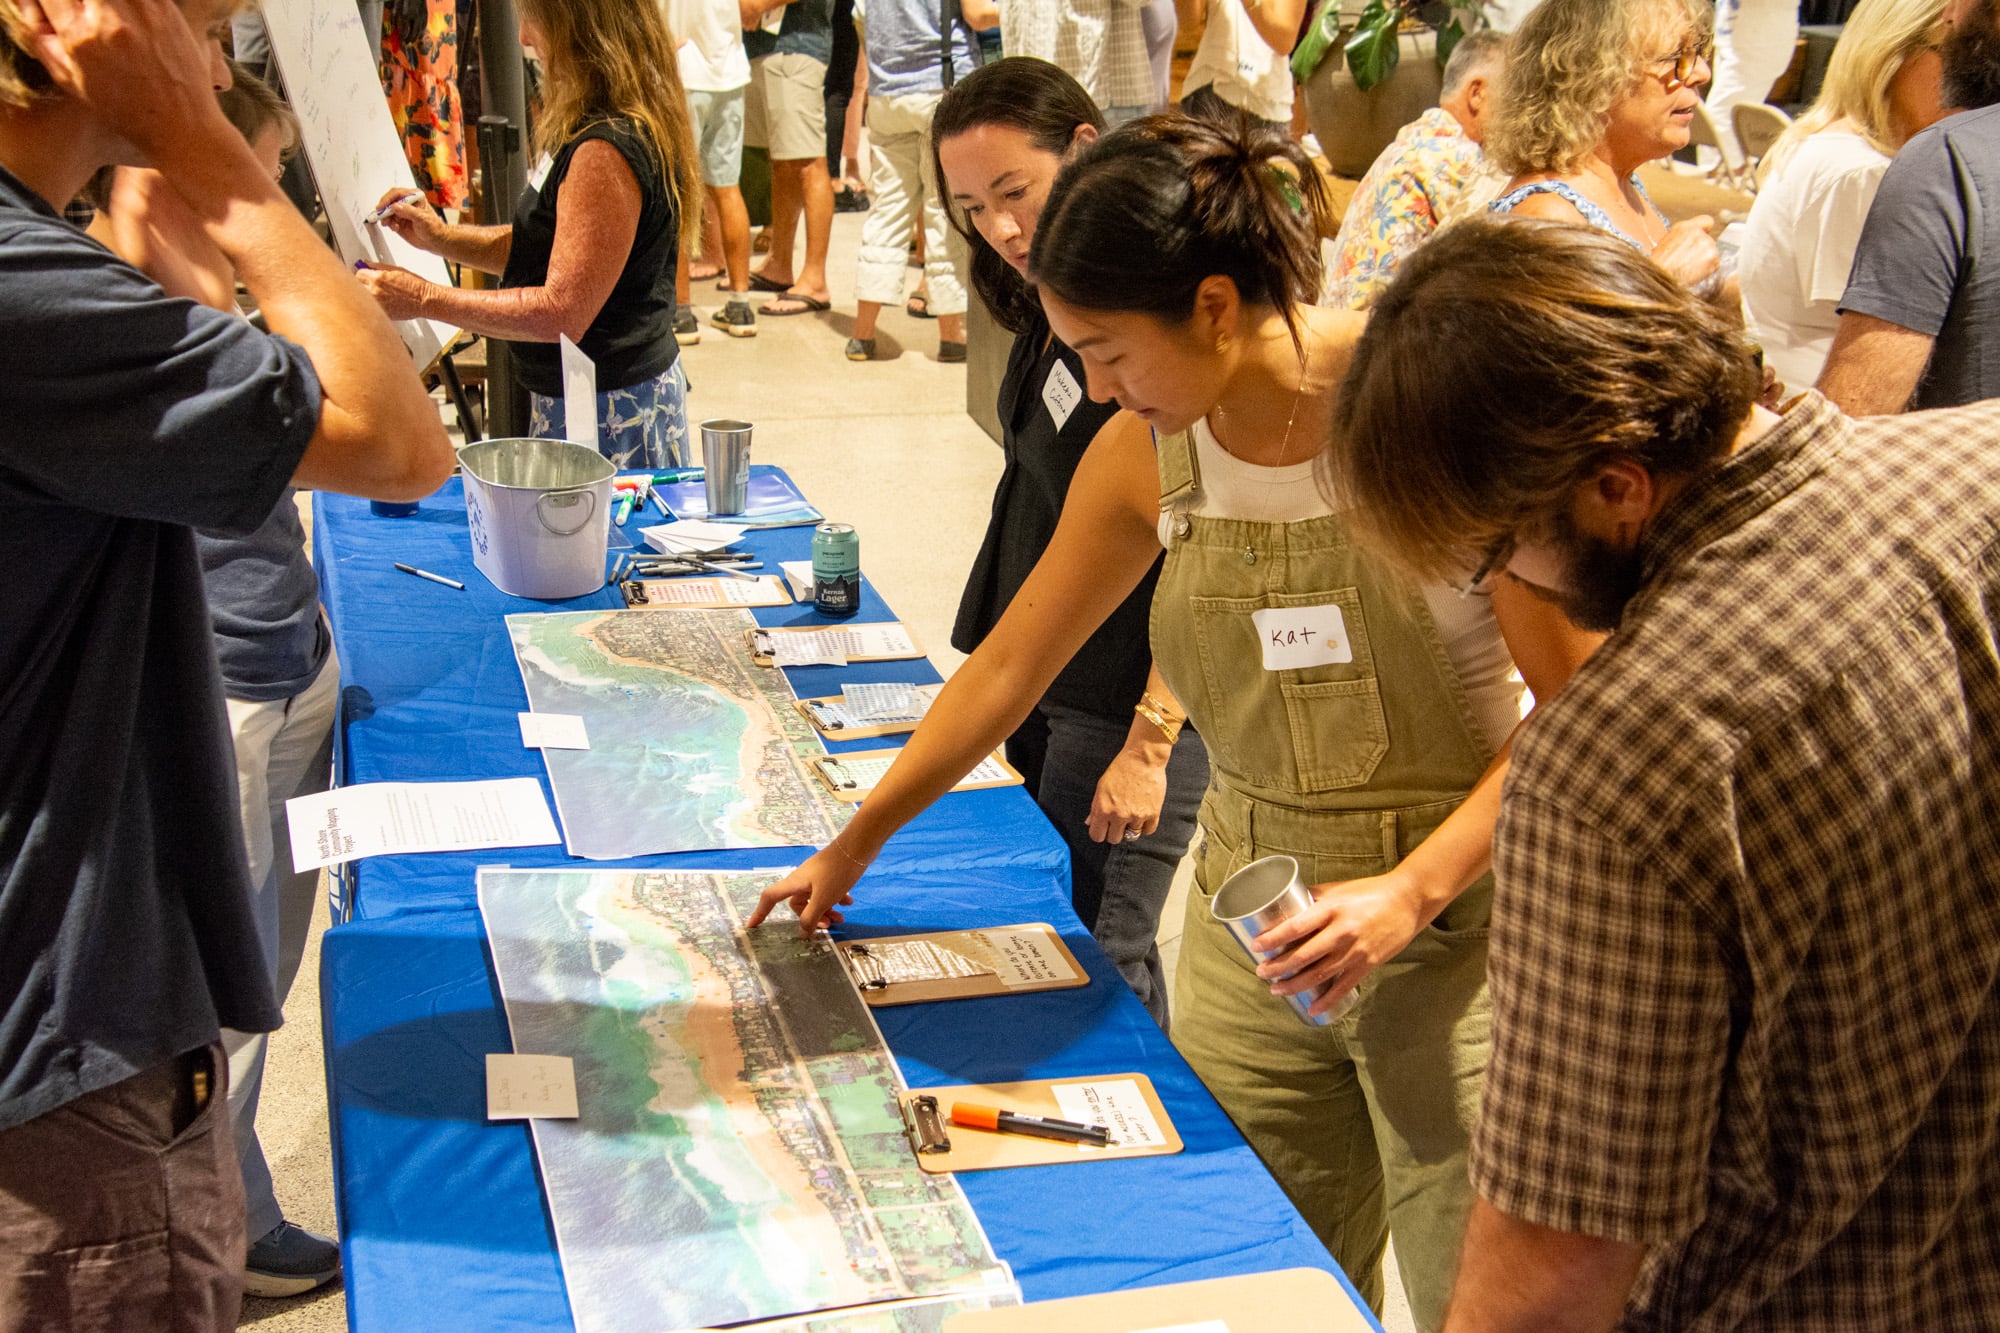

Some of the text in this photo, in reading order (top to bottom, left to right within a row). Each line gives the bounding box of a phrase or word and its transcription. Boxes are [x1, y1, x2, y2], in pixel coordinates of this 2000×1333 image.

[821, 593, 847, 603] Lager
[327, 807, 340, 829] Mapping
[319, 844, 330, 860] North
[343, 834, 356, 854] Project
